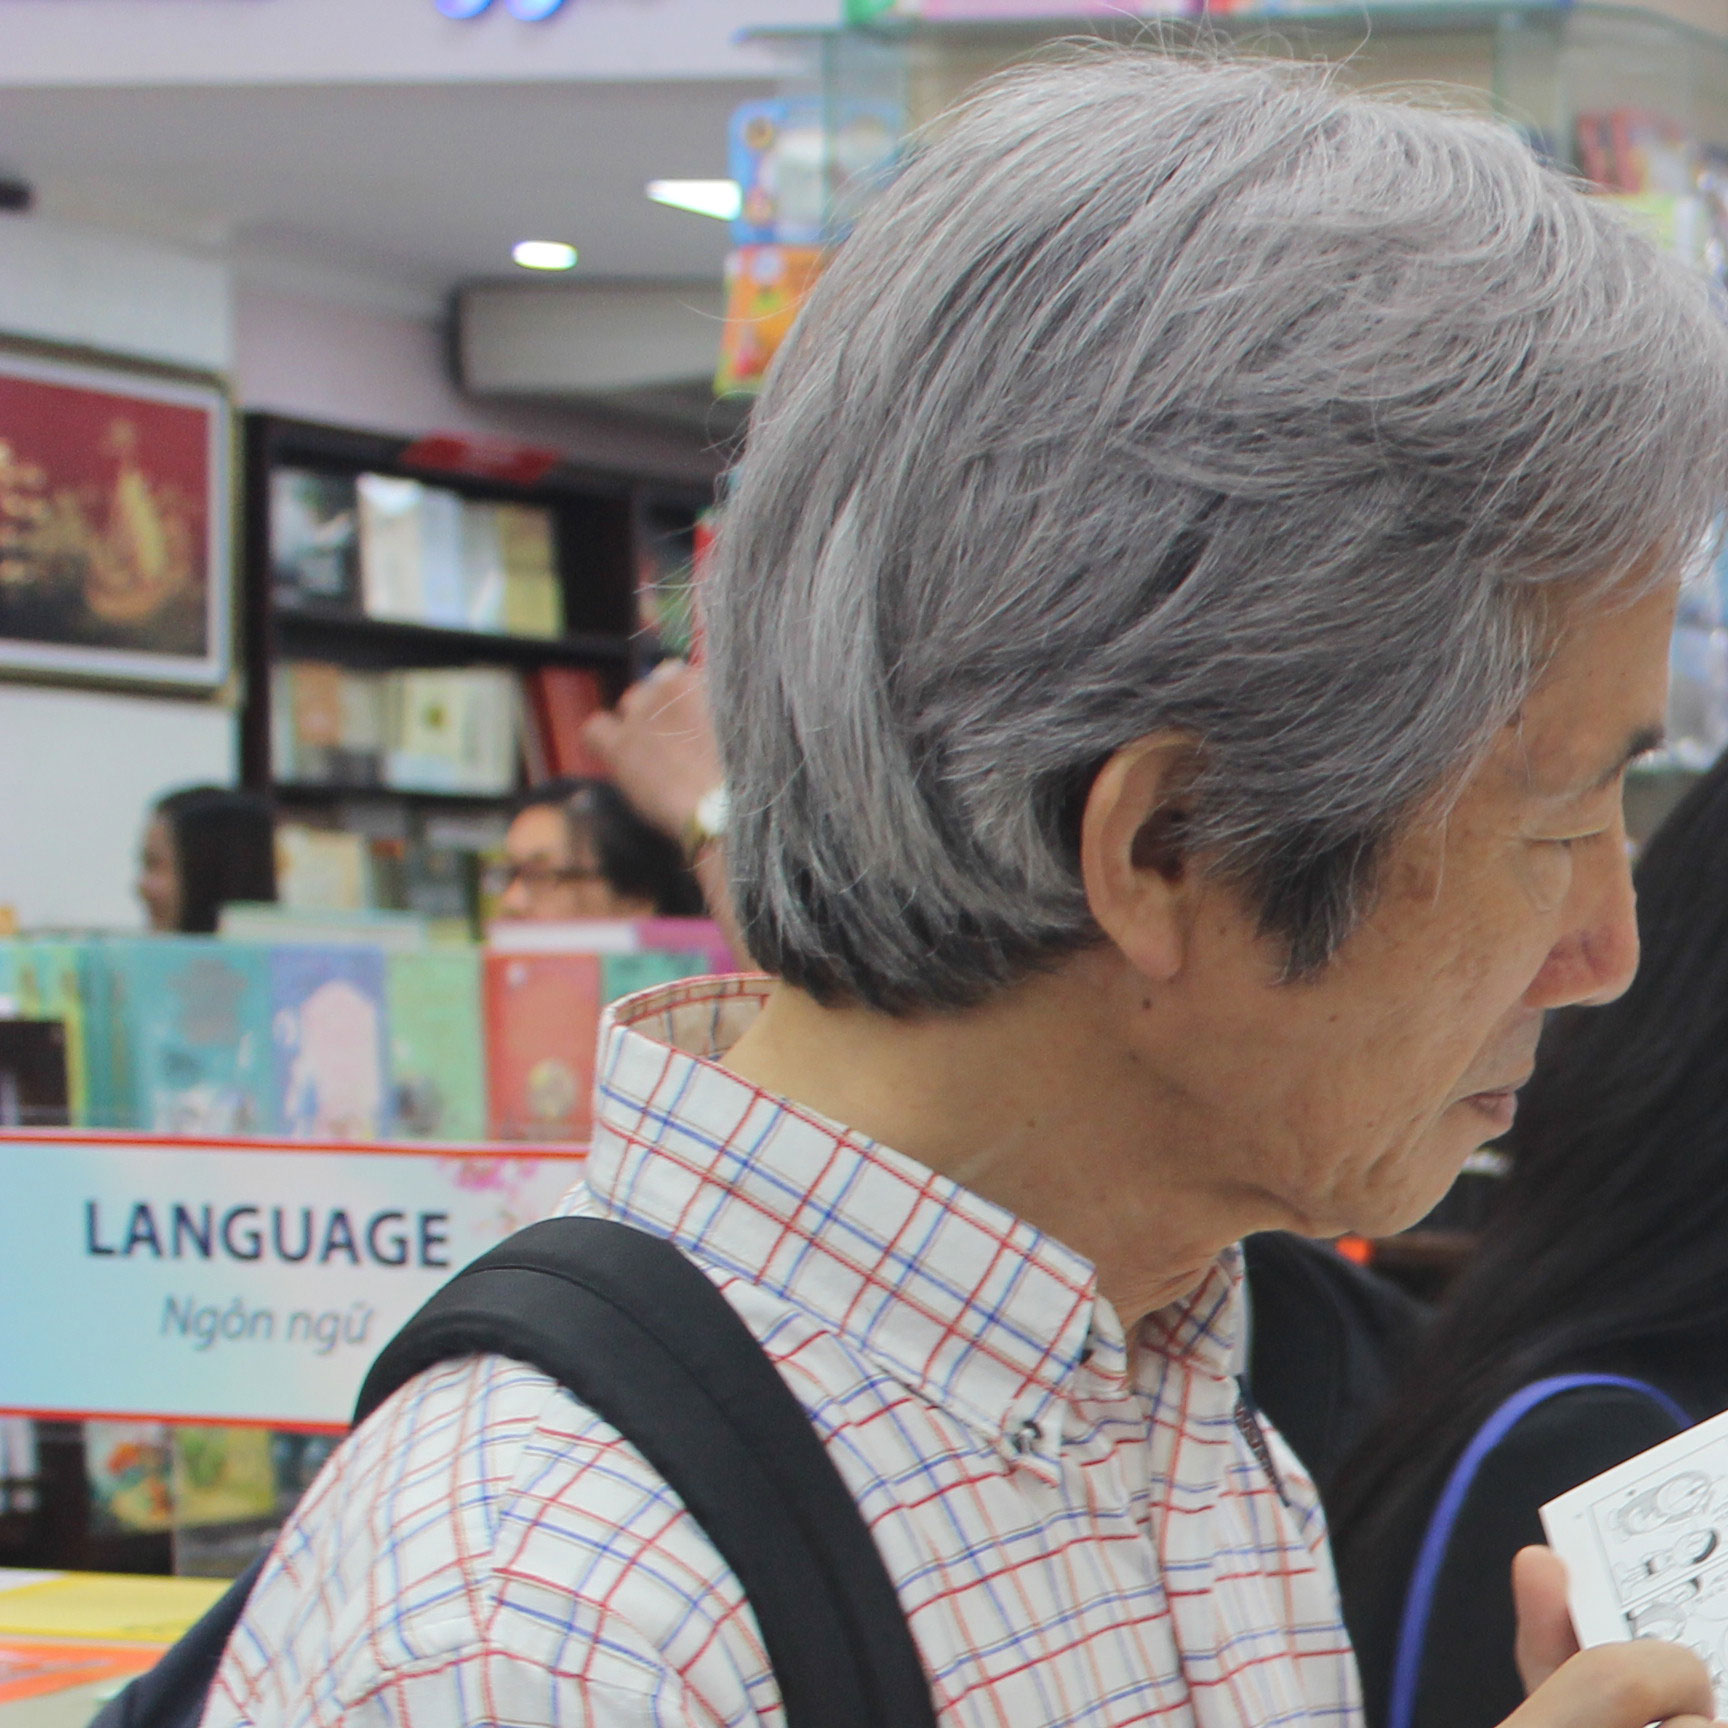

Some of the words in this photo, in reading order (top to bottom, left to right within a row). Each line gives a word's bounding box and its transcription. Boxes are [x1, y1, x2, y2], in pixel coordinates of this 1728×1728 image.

[84, 1200, 452, 1269] LANGUAGE
[160, 1294, 278, 1354] Ngôn
[288, 1298, 378, 1356] ngữ
